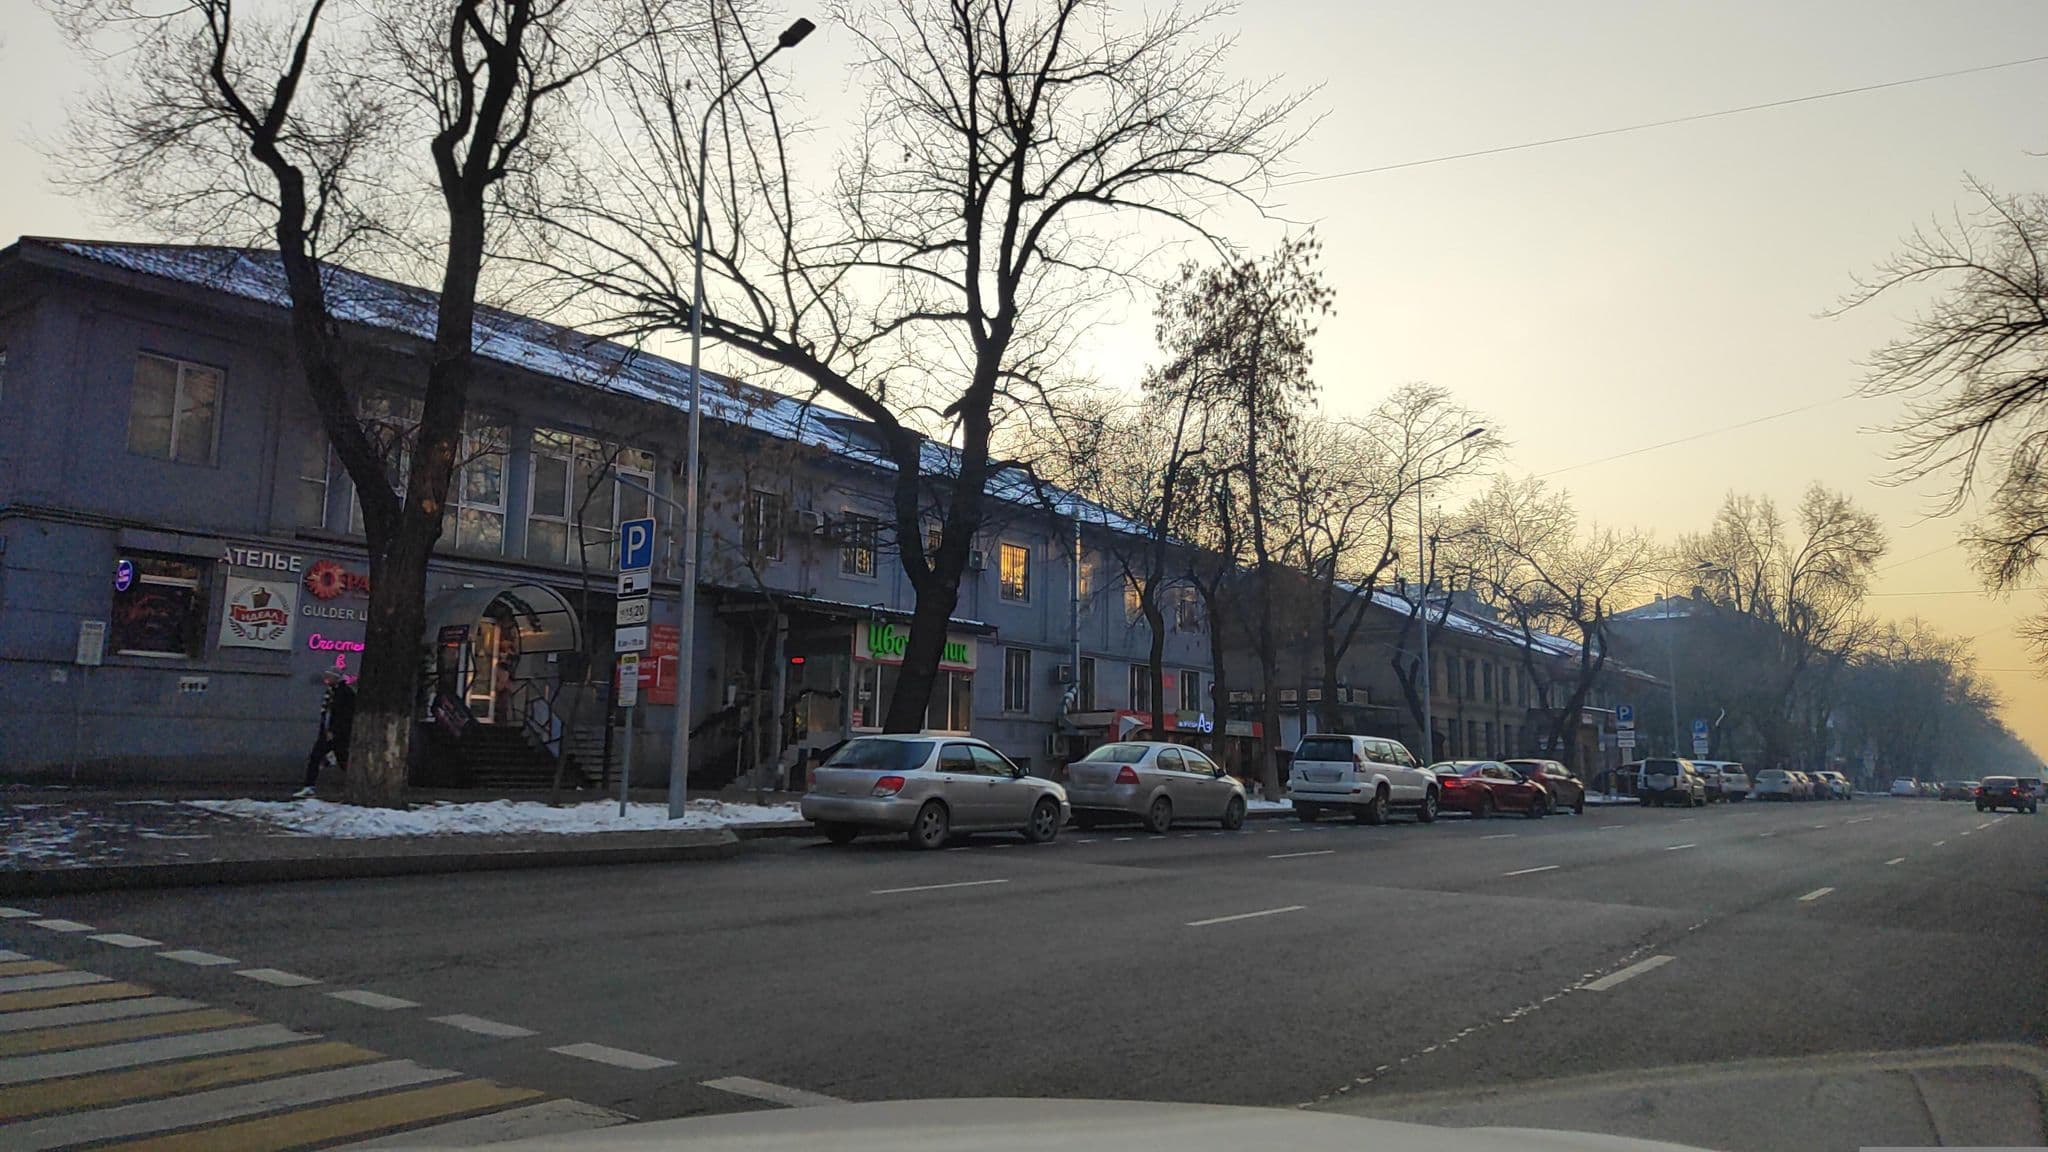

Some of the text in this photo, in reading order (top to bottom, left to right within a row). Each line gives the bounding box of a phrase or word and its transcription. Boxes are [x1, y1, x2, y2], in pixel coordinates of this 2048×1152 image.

[627, 525, 646, 565] P
[218, 547, 301, 572] АТЕЛЬЕ
[303, 606, 354, 619] GULDER
[635, 605, 644, 616] 20
